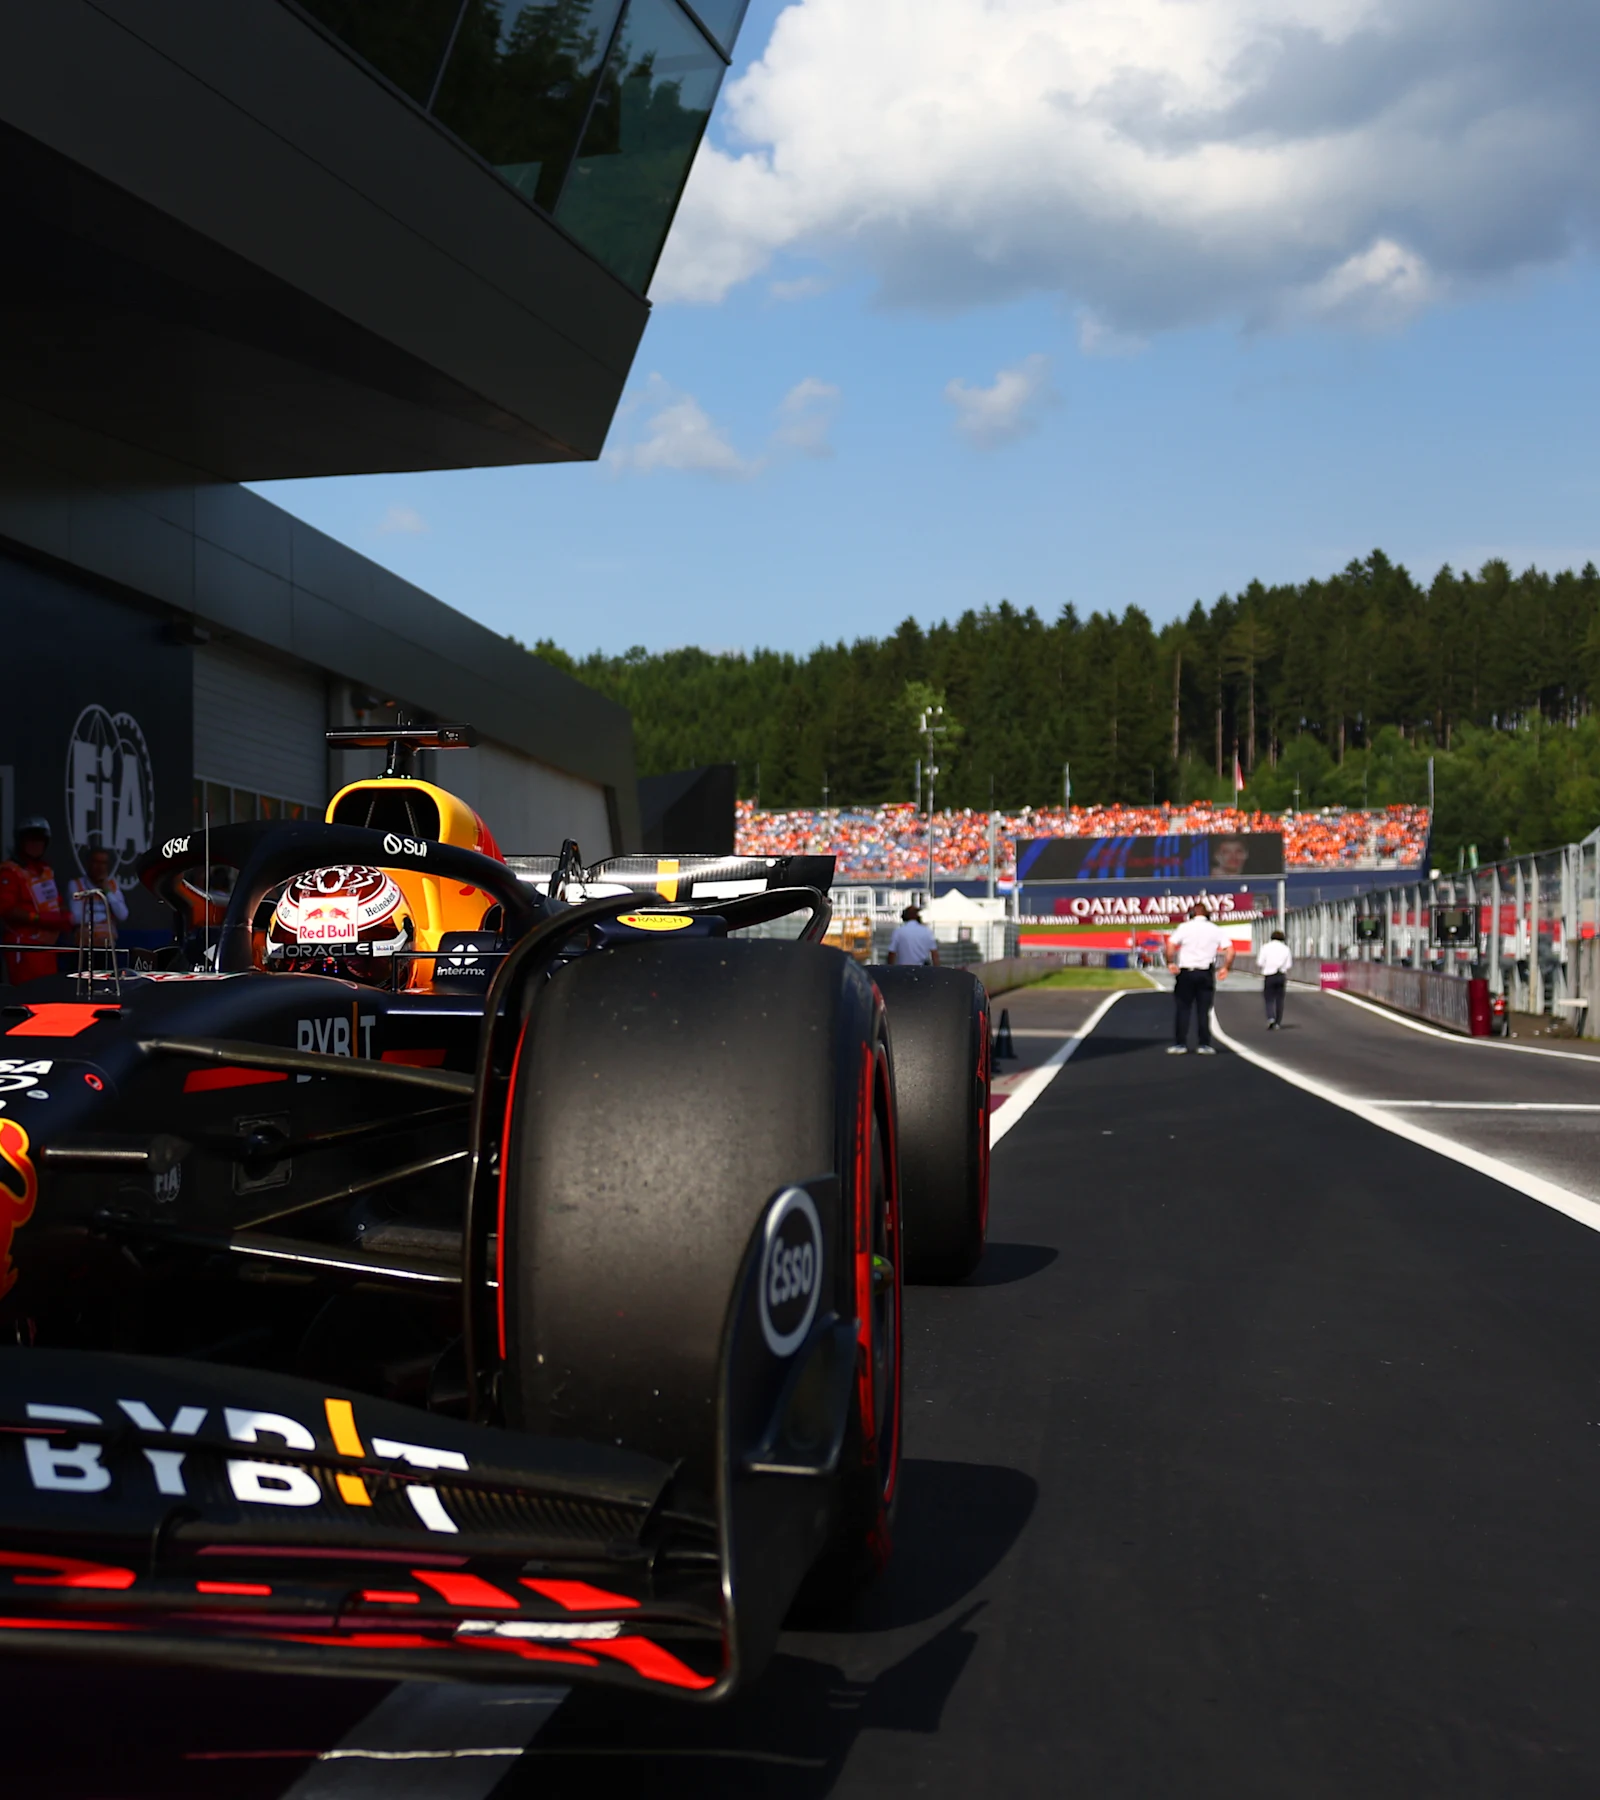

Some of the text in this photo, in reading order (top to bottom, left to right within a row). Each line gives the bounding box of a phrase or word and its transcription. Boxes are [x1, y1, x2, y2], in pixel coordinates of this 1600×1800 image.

[173, 835, 191, 852] Sui
[403, 838, 427, 857] Sui
[365, 888, 396, 917] Heineken
[1070, 893, 1235, 916] QATAR AIRWAYS
[637, 916, 683, 924] RAUCH
[1040, 914, 1079, 925] AIRWAYS
[1094, 915, 1128, 925] QATAR
[1128, 914, 1170, 924] AIRWAYS
[299, 923, 355, 939] Red Bull
[285, 942, 370, 957] ORACLE
[437, 966, 486, 976] inter.mx
[4, 1002, 122, 1037] 1
[771, 1238, 812, 1307] Esso
